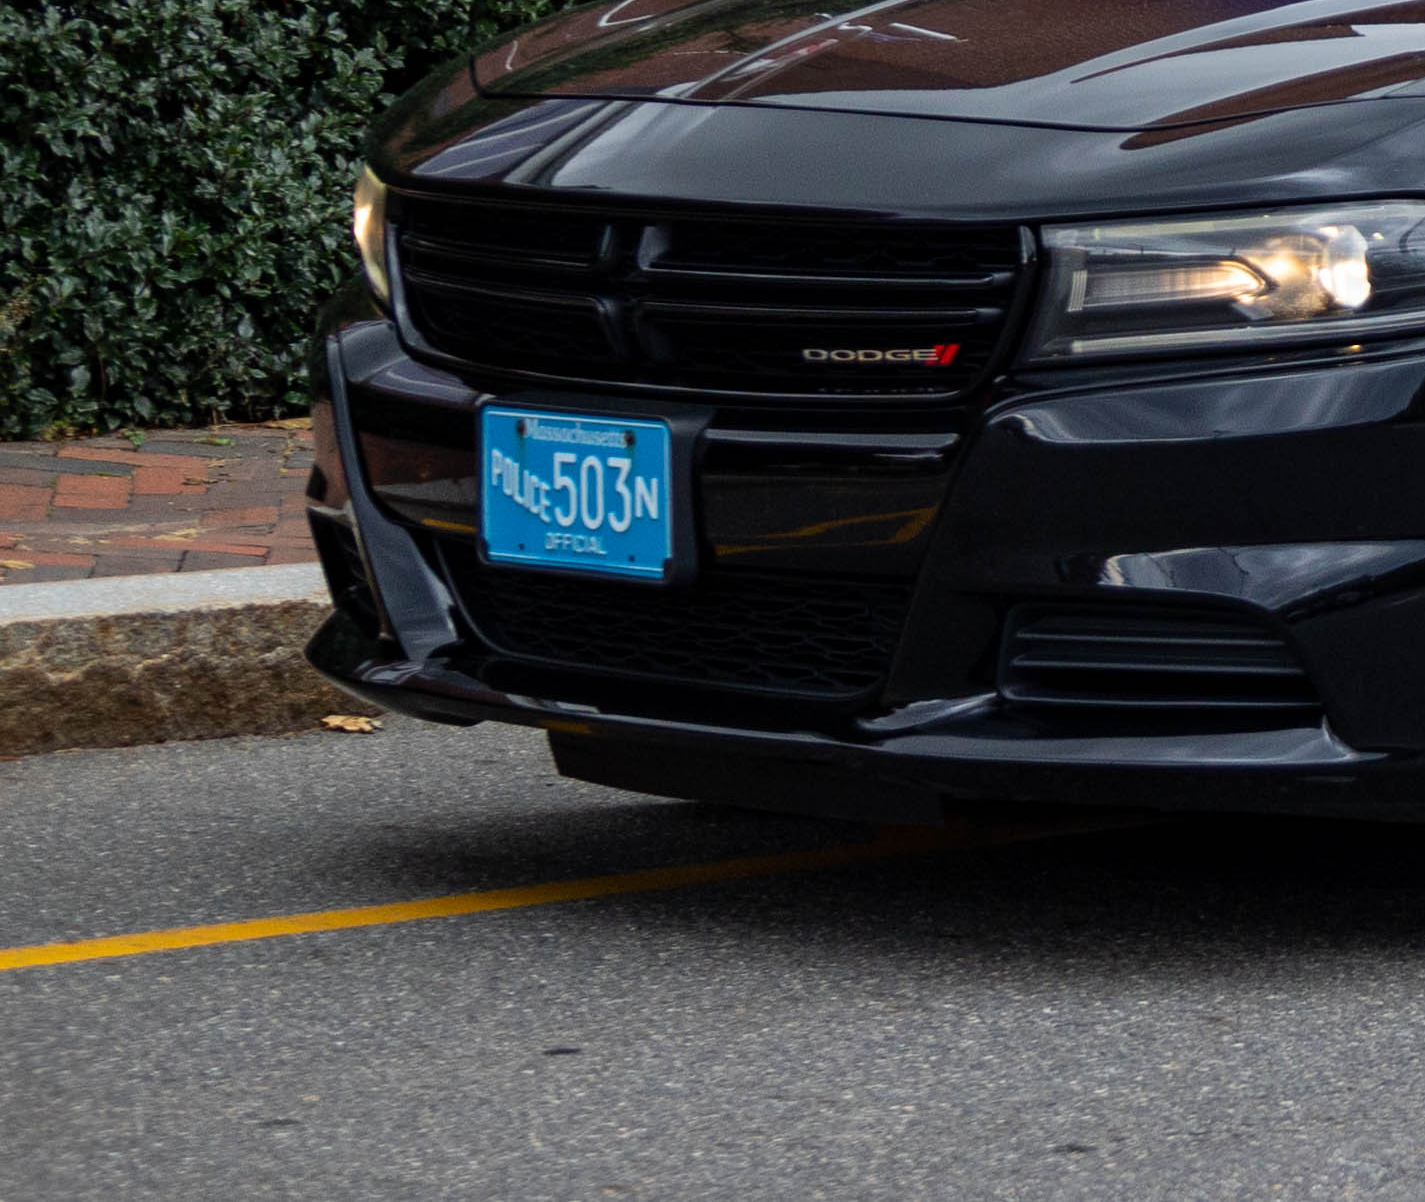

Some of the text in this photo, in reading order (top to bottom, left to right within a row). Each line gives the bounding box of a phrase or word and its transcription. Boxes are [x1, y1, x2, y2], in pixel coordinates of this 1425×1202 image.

[801, 347, 940, 363] DODGE
[523, 417, 629, 449] Massachusetts
[490, 448, 552, 524] POLICE
[545, 531, 609, 556] OFFICIAL
